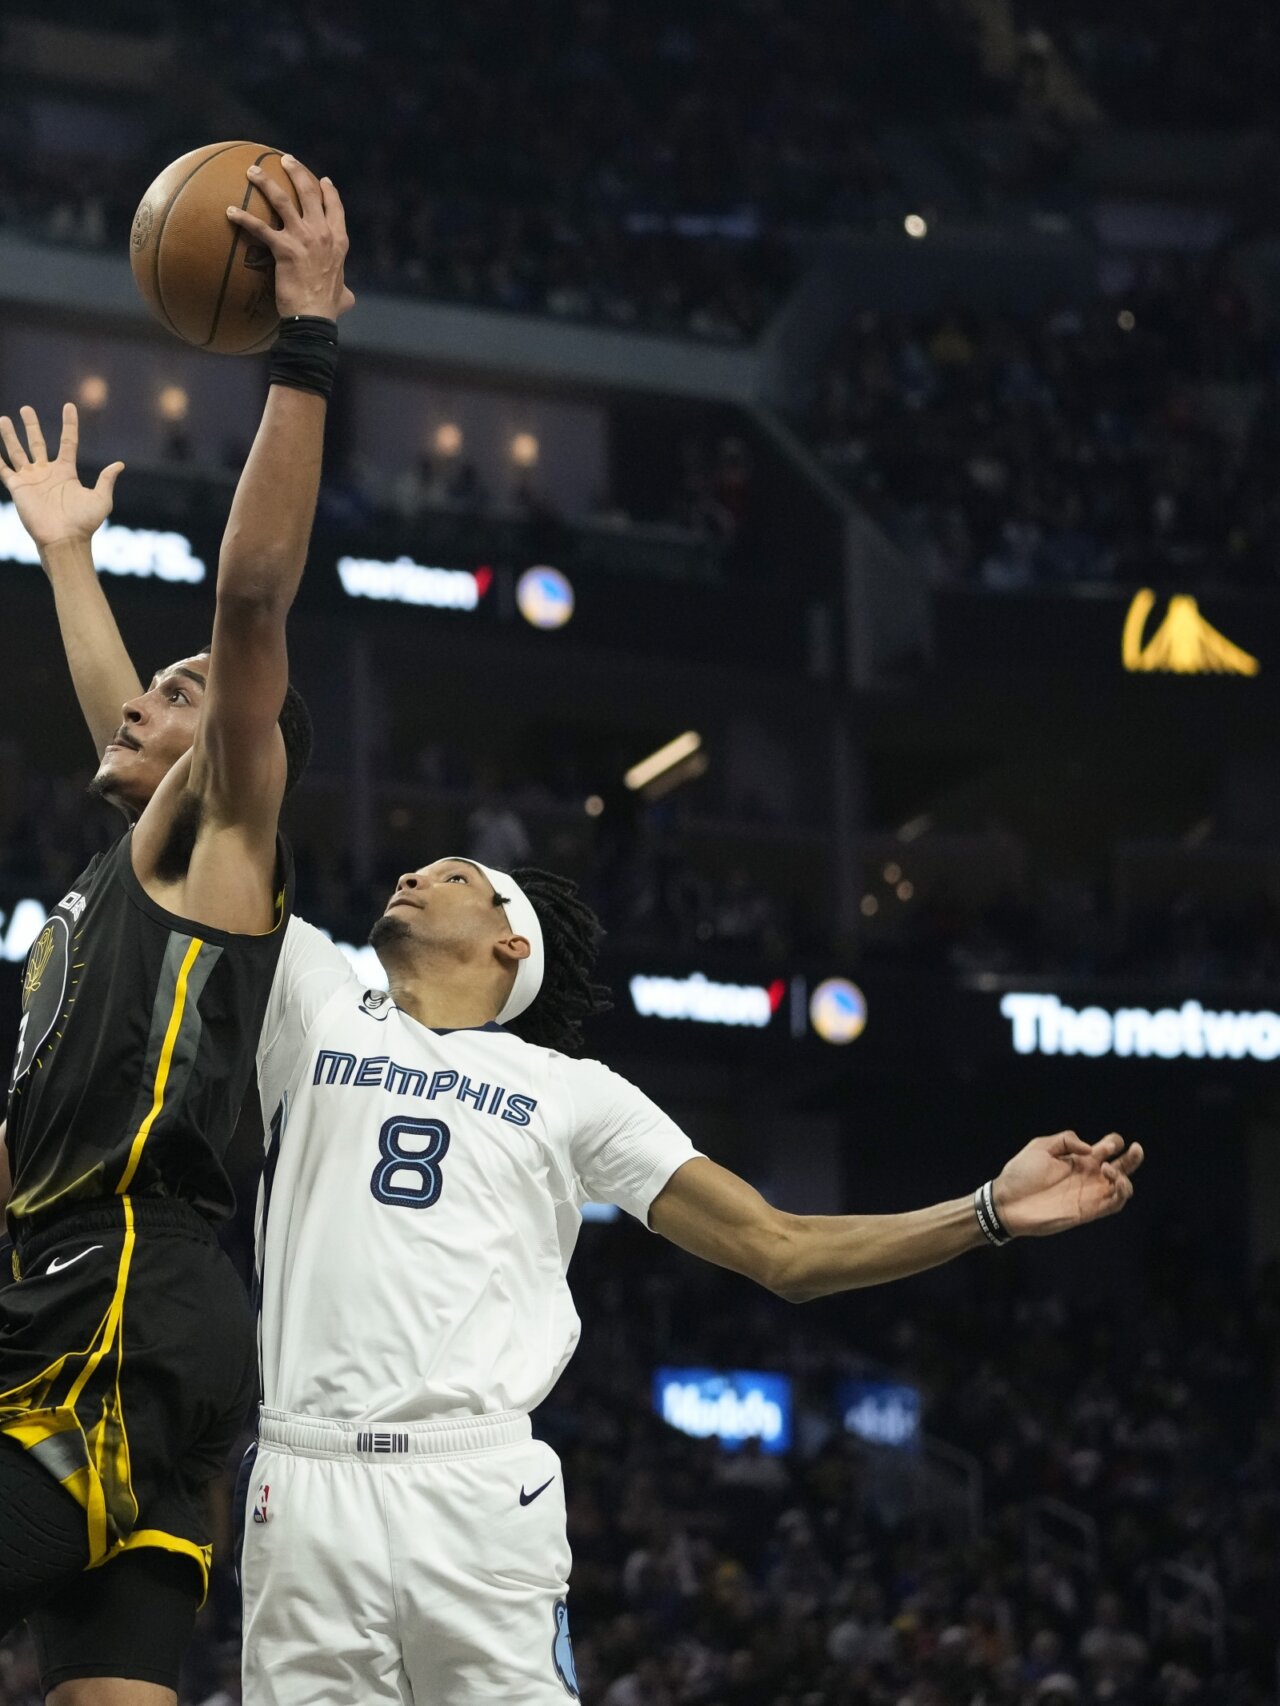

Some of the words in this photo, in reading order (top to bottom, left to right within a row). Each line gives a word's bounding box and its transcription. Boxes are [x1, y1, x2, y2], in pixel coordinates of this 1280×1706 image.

[1000, 992, 1113, 1058] The
[312, 1050, 538, 1127] MEMPHIS
[370, 1115, 450, 1209] 8
